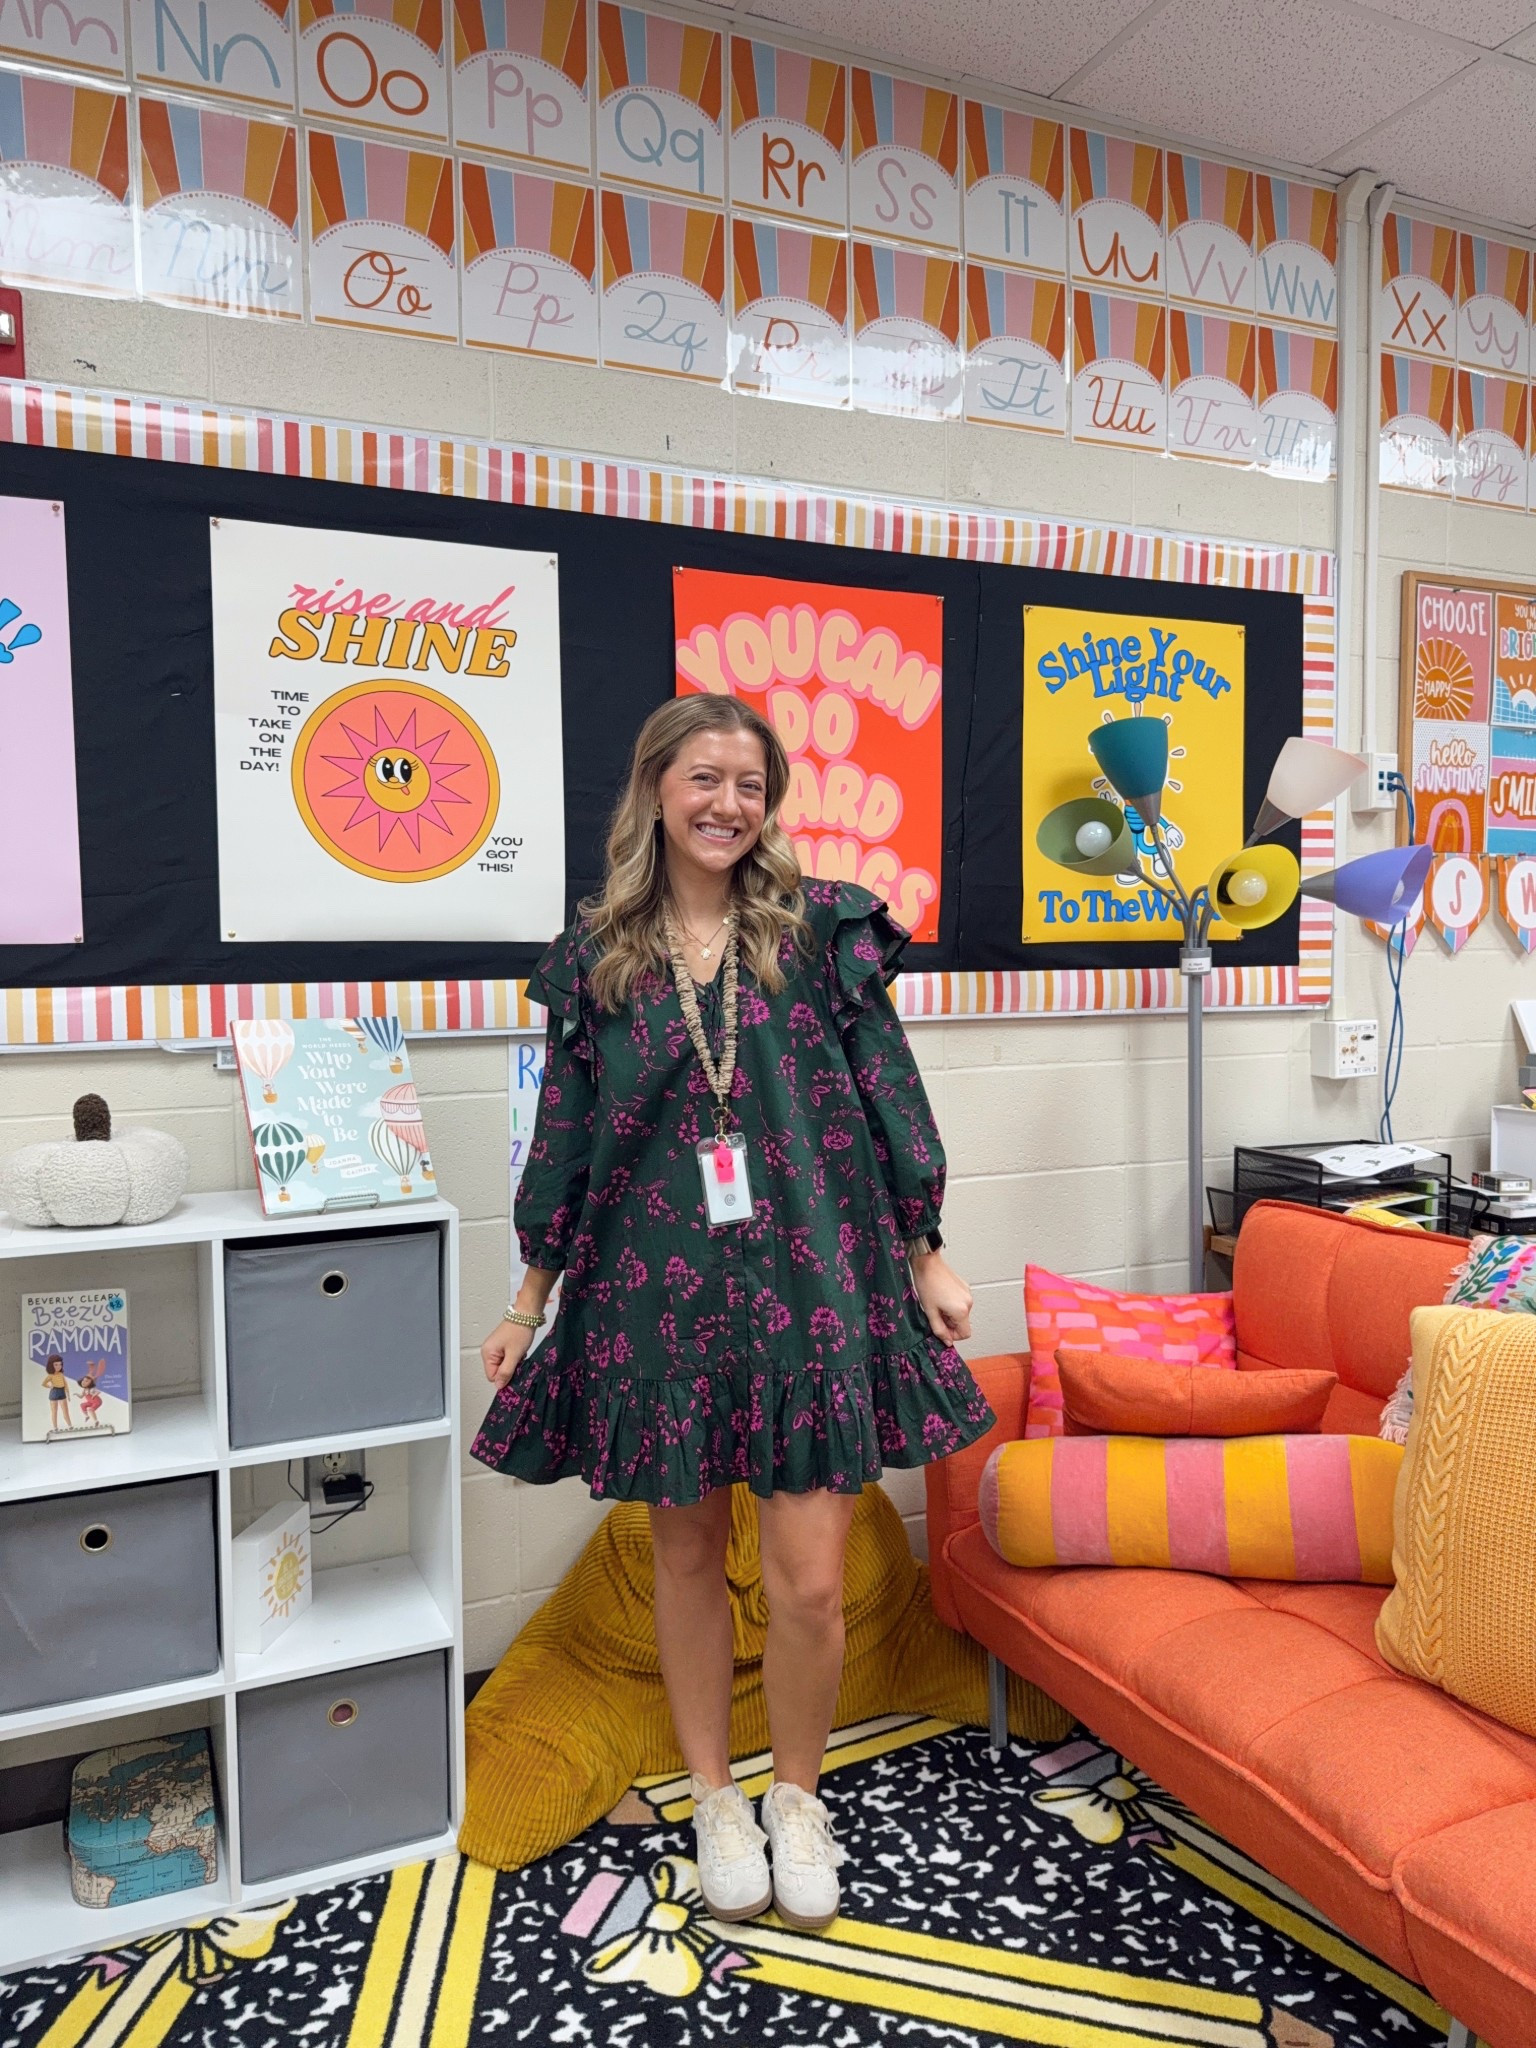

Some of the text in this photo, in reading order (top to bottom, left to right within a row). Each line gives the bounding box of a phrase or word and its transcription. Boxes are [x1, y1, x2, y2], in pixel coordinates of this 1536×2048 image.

[155, 0, 282, 89] Nn
[316, 31, 429, 116] Oo
[487, 58, 563, 155] Pp
[614, 93, 705, 193] Qq
[762, 132, 826, 208] Rr
[874, 157, 938, 231] Ss
[1077, 217, 1159, 283] Uu
[1176, 236, 1248, 305] Vv
[495, 261, 575, 348] Pp
[1262, 257, 1336, 322] Ww
[1391, 286, 1447, 351] Xx
[1466, 307, 1520, 370] Yy
[288, 579, 516, 629] rise and
[1421, 595, 1488, 636] CHOOSE
[268, 607, 518, 678] SHINE
[1037, 627, 1232, 700] Shine Your
[1088, 656, 1185, 702] Light
[270, 690, 309, 702] TIME
[1423, 680, 1451, 699] HAPPY
[248, 717, 292, 730] TAKE
[277, 705, 301, 716] TO
[768, 686, 857, 758] DO
[249, 746, 282, 758] THE
[259, 733, 284, 744] ON
[1431, 739, 1476, 768] hello
[240, 760, 280, 772] DAY!
[1415, 764, 1484, 796] SUNSHINE
[776, 758, 900, 840] ARD
[486, 849, 518, 859] GOT
[491, 836, 523, 846] YOU
[477, 862, 513, 872] THIS!
[1038, 890, 1080, 923] To
[1082, 890, 1140, 923] The
[1449, 869, 1467, 915] S
[297, 1065, 336, 1079] You
[305, 1051, 352, 1070] Who
[297, 1095, 352, 1116] Made
[315, 1081, 368, 1095] Were
[333, 1127, 359, 1142] Be
[27, 1296, 74, 1306] BEVERLY
[53, 1319, 75, 1327] AND
[29, 1325, 122, 1360] RAMONA
